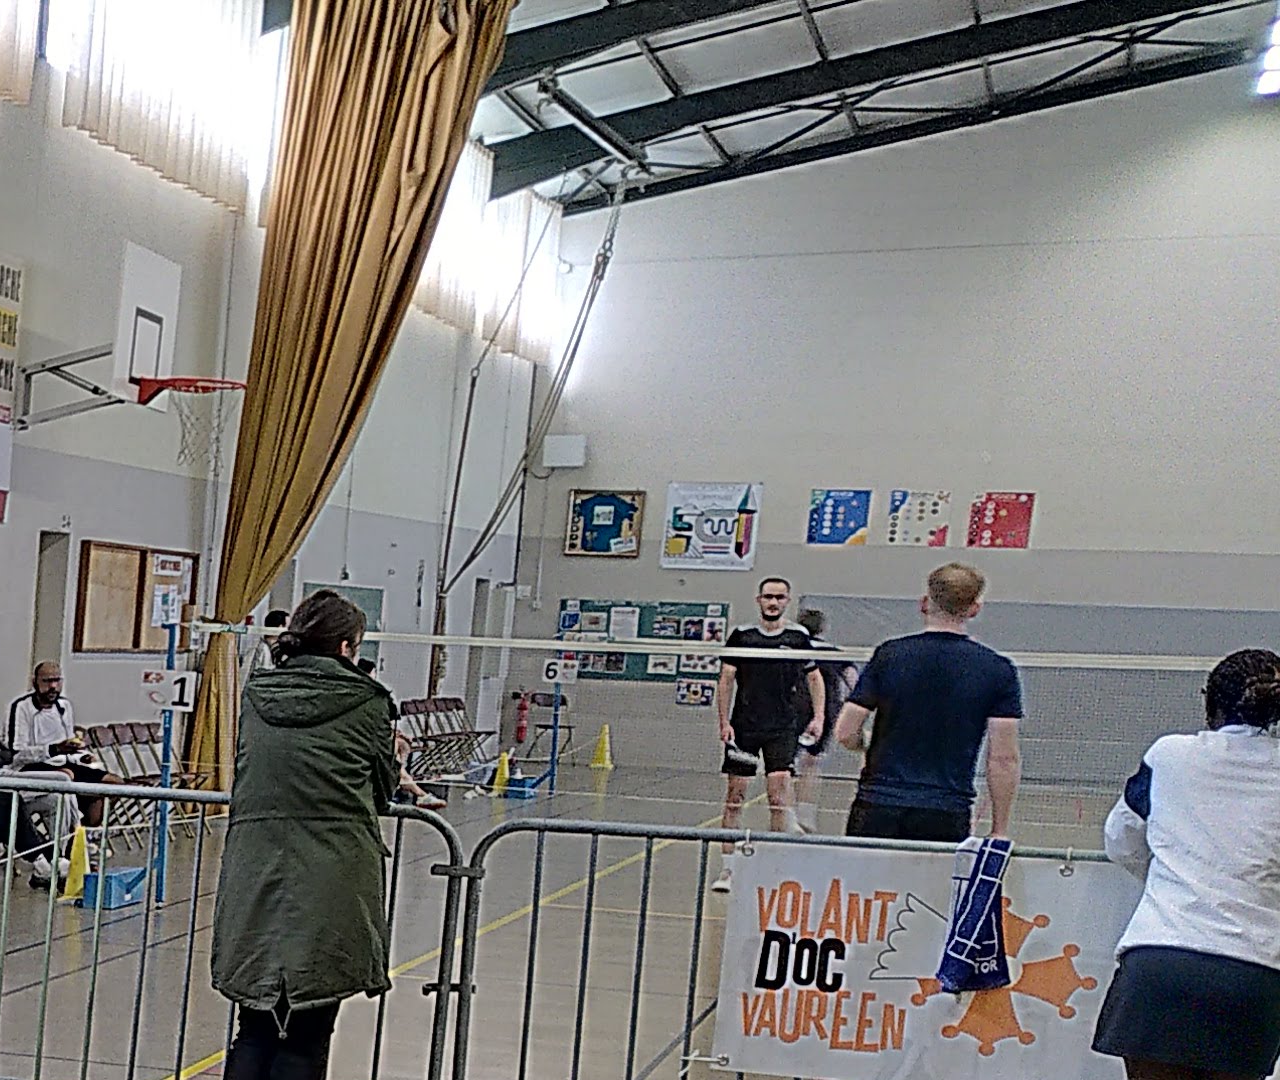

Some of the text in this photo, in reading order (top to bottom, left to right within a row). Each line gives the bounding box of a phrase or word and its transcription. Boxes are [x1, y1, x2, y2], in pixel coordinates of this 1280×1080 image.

[171, 677, 190, 707] 1
[545, 662, 560, 680] 6
[757, 878, 898, 944] VOLANT
[742, 987, 906, 1053] VAUREEN
